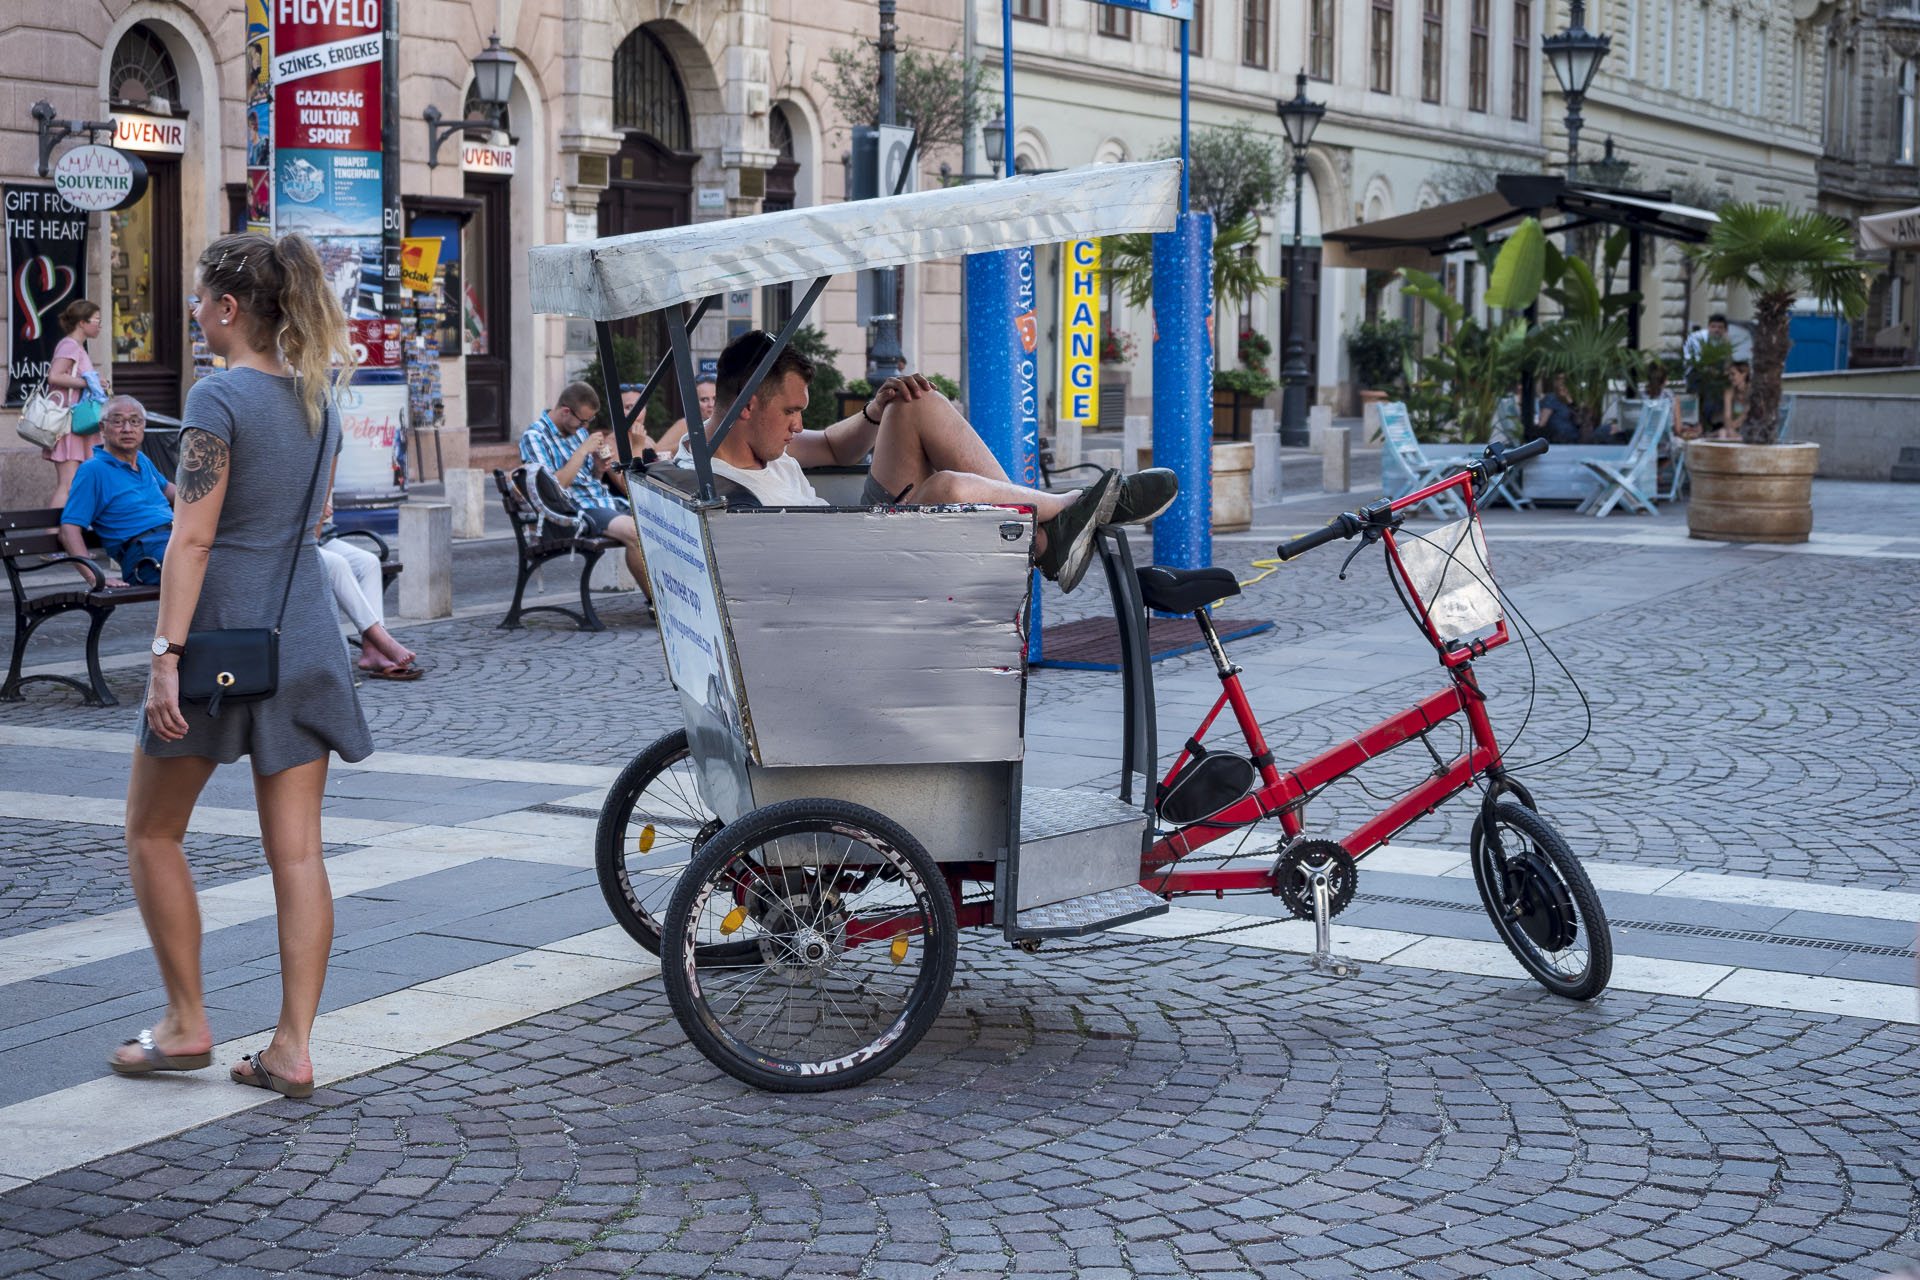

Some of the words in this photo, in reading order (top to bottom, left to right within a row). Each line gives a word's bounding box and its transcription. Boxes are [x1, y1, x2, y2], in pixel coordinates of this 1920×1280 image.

[278, 52, 328, 77] SZÍNES,
[328, 40, 380, 65] ÉRDEKES
[295, 89, 364, 108] GAZDASÁG
[300, 107, 360, 127] KULTÚRA
[308, 127, 352, 144] SPORT
[333, 156, 368, 168] BUDAPEST
[462, 147, 513, 168] UVENIR
[57, 174, 129, 190] SOUVENIR
[5, 190, 39, 211] GIFT
[44, 193, 88, 214] FRO
[8, 218, 35, 239] THE
[40, 220, 87, 241] HEART
[401, 267, 429, 284] odak
[1015, 245, 1033, 313] ÁROS
[1071, 240, 1095, 419] CHANGE
[1016, 360, 1036, 424] JÖVŐ
